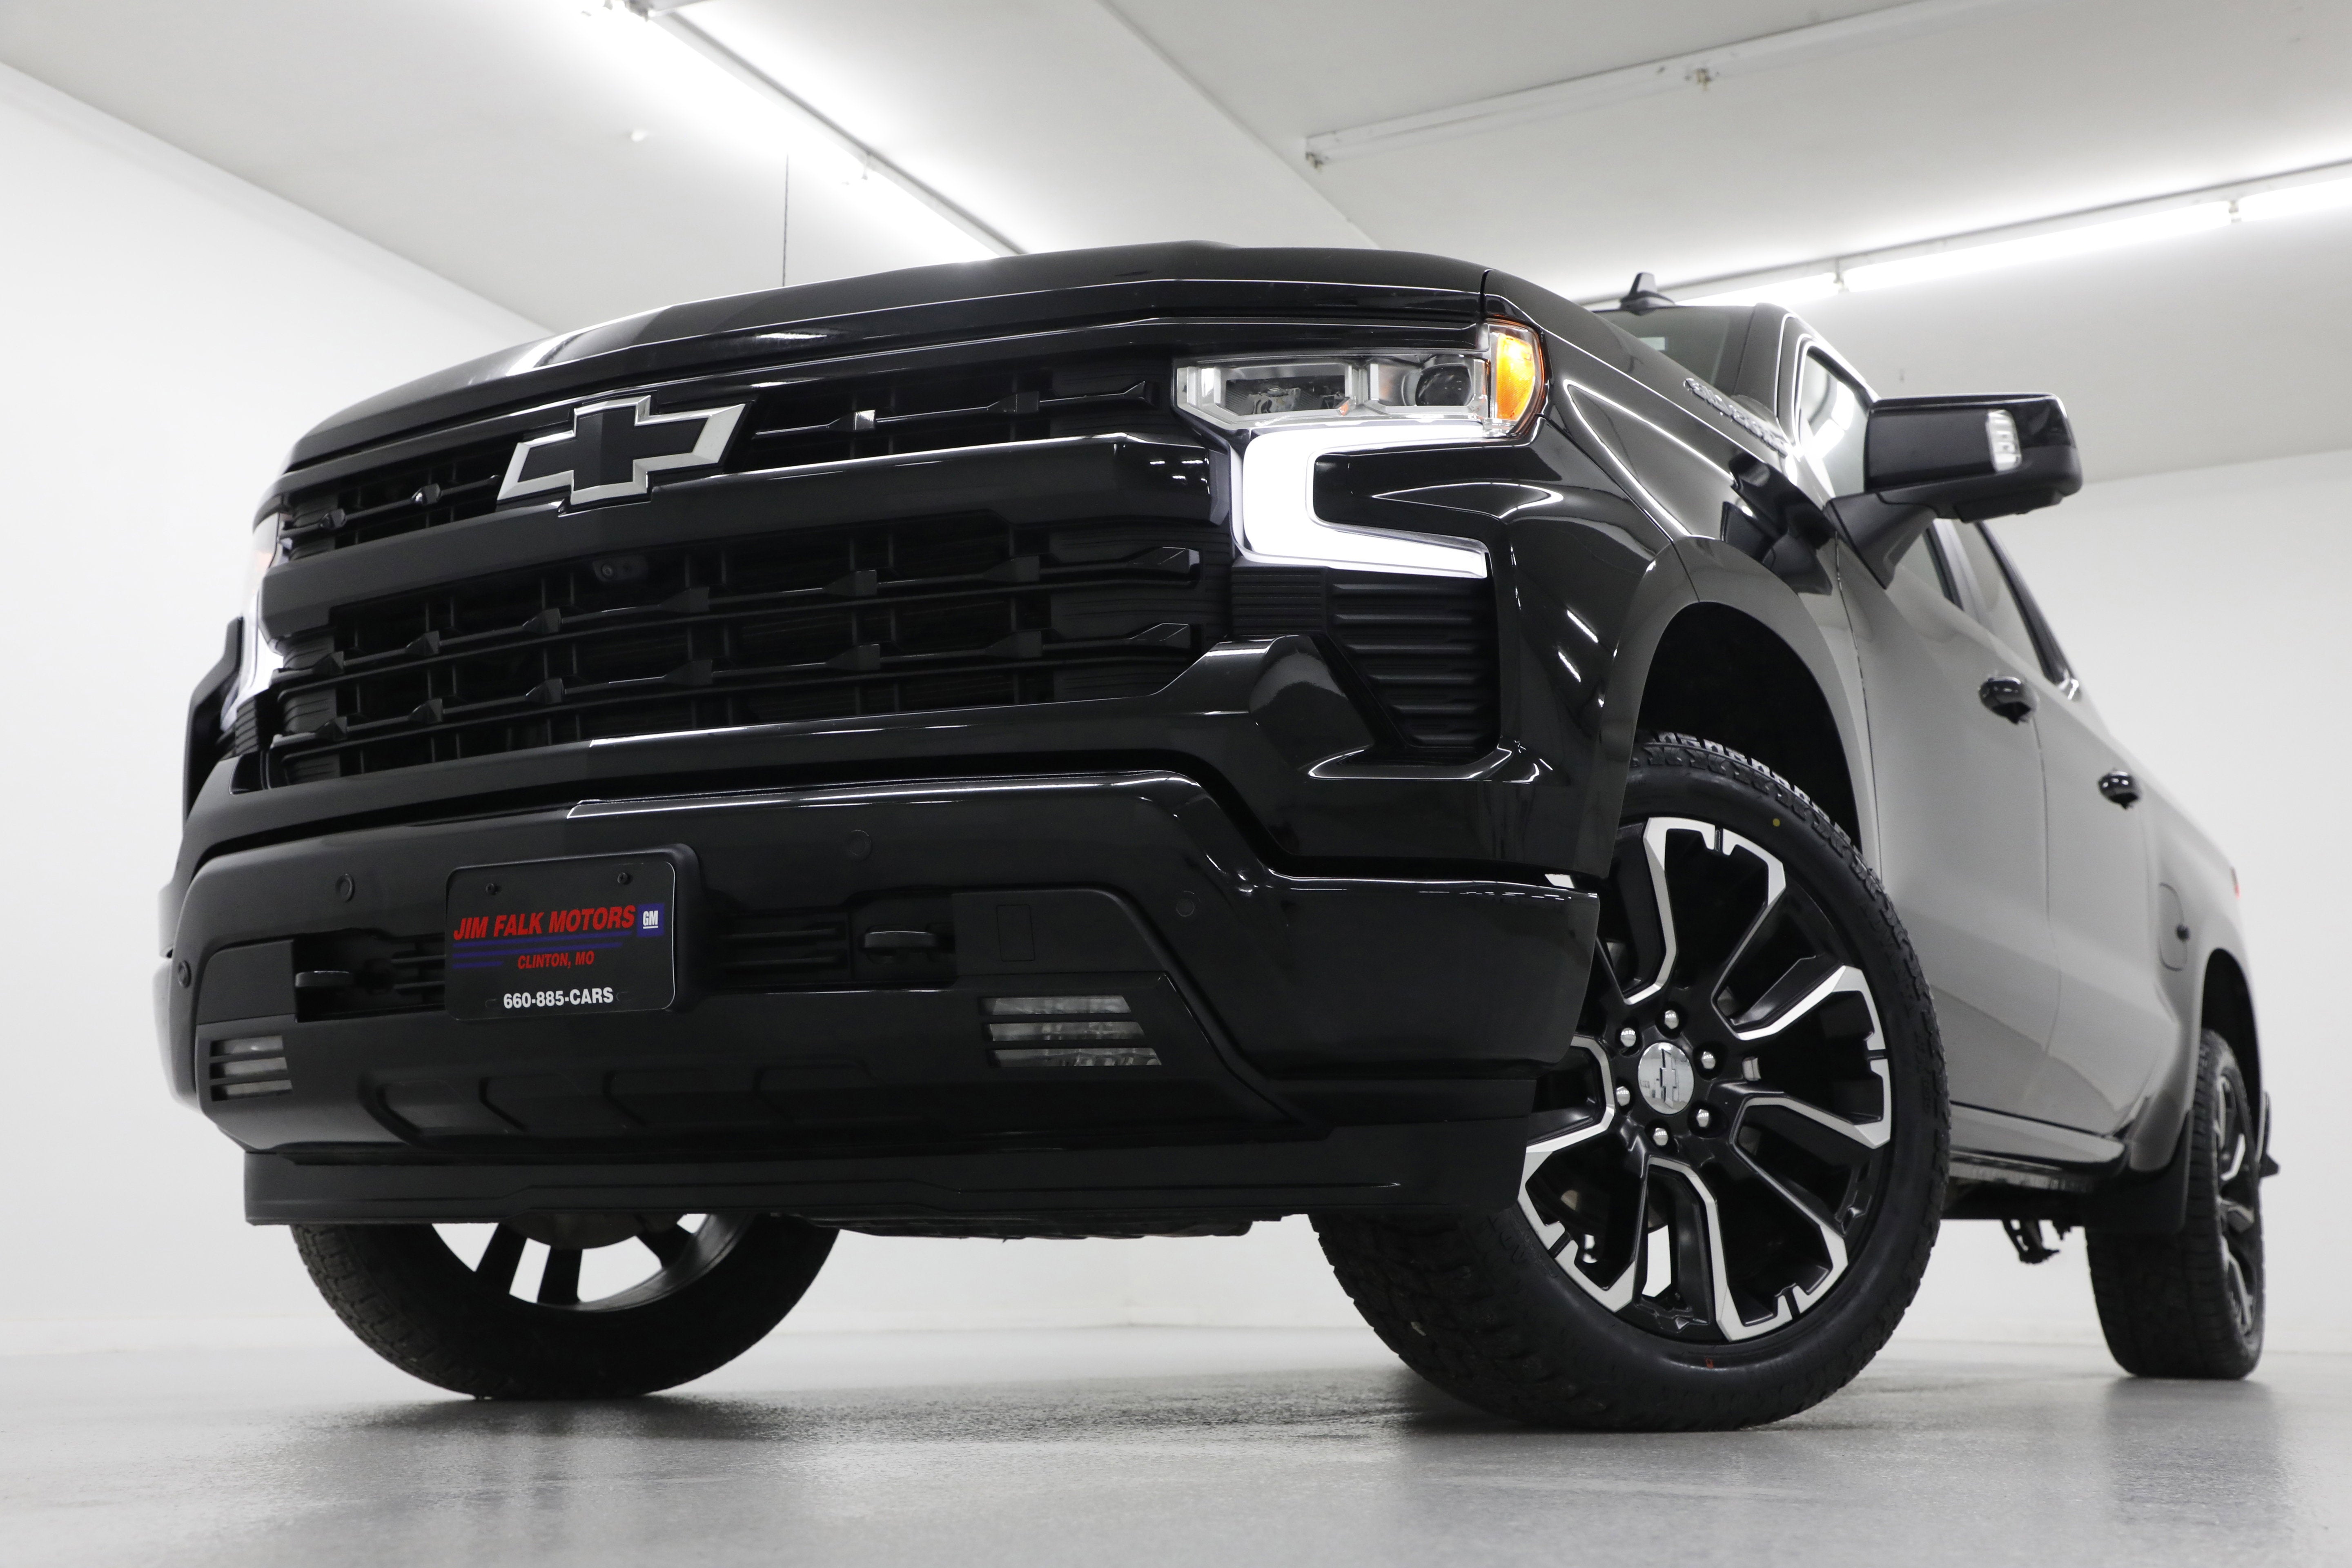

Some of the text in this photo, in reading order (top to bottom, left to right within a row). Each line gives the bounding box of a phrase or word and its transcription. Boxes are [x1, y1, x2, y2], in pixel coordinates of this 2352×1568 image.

[453, 904, 636, 940] JIM FALK MOTORS
[643, 910, 659, 927] GM
[517, 950, 595, 969] CLINTON, MO
[503, 987, 614, 1009] 660-885-CARS
